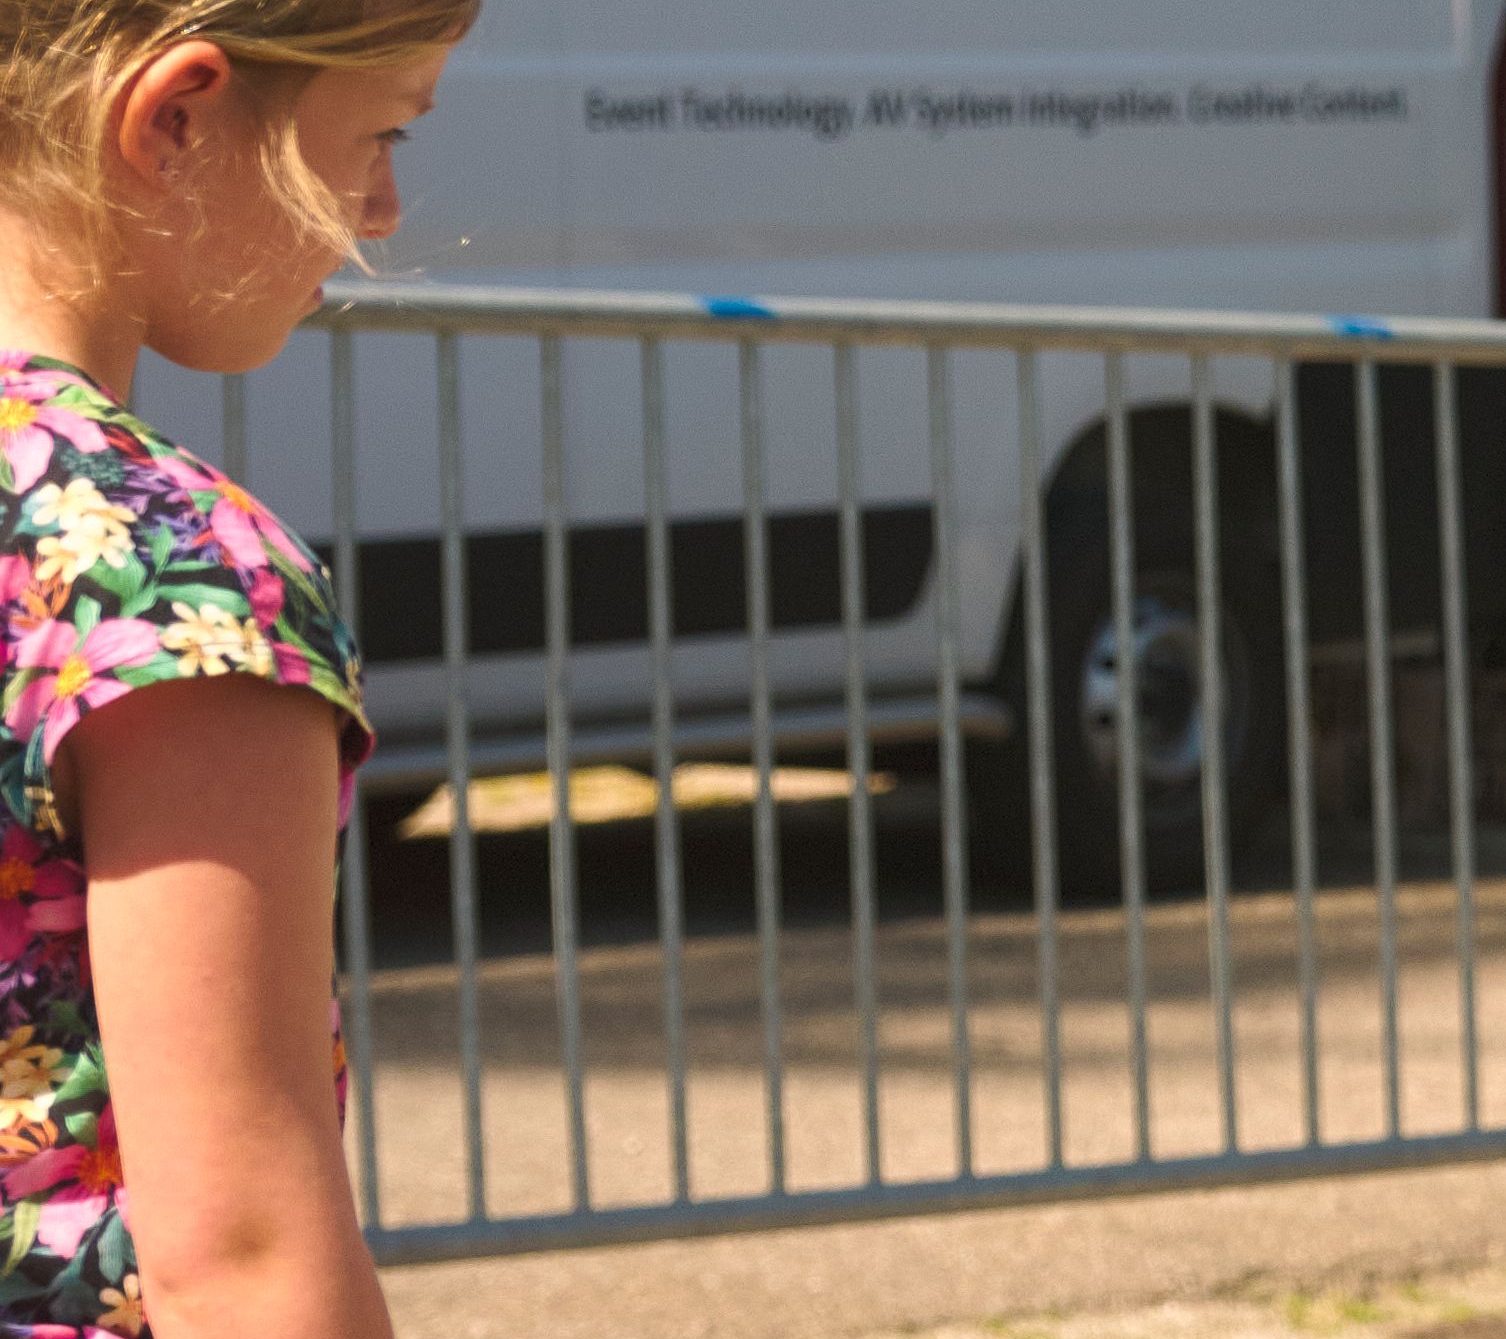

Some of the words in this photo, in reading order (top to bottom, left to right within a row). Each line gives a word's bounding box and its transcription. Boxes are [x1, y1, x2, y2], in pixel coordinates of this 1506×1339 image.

[585, 85, 668, 133] Event
[913, 85, 1015, 139] System
[1189, 83, 1296, 126] Creative
